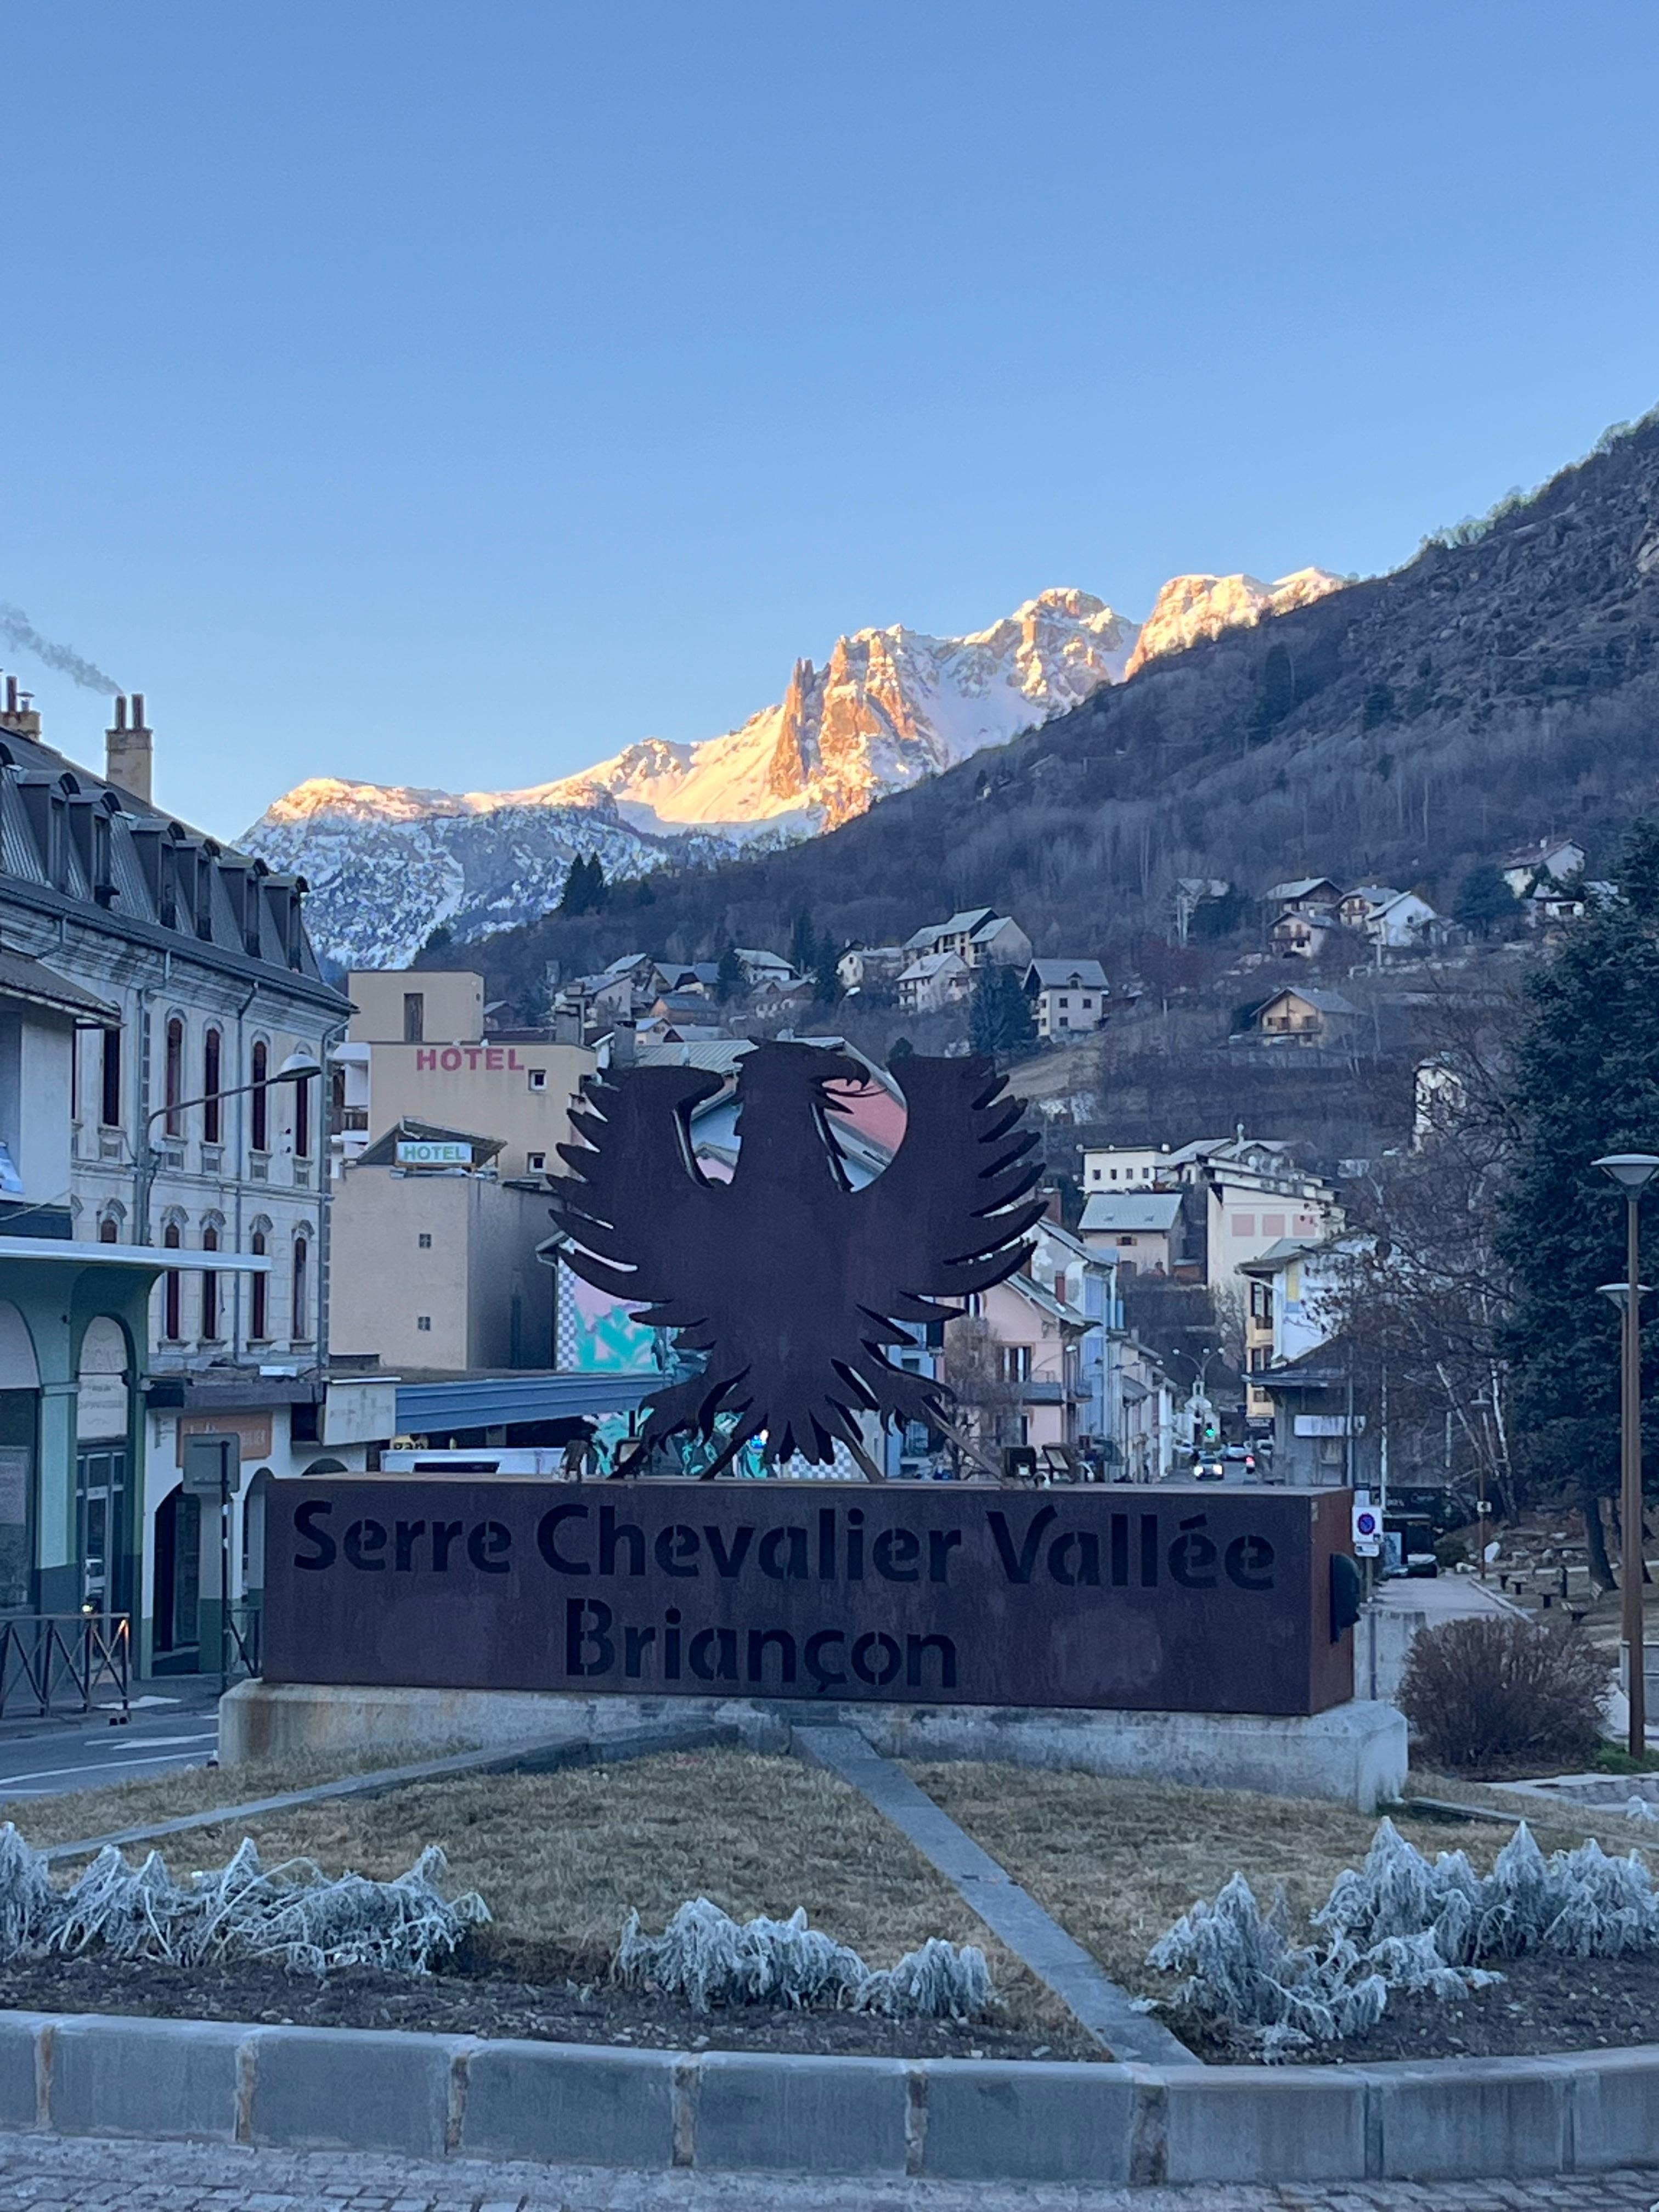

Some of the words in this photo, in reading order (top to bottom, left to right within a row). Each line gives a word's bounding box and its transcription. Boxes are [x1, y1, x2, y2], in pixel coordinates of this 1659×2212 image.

[416, 1048, 524, 1071] HOTEL
[403, 1145, 466, 1160] HOTEL
[294, 1500, 512, 1573] Serre
[537, 1503, 962, 1582] Chevalier
[986, 1504, 1274, 1590] Vallée
[566, 1598, 956, 1692] Briançon
